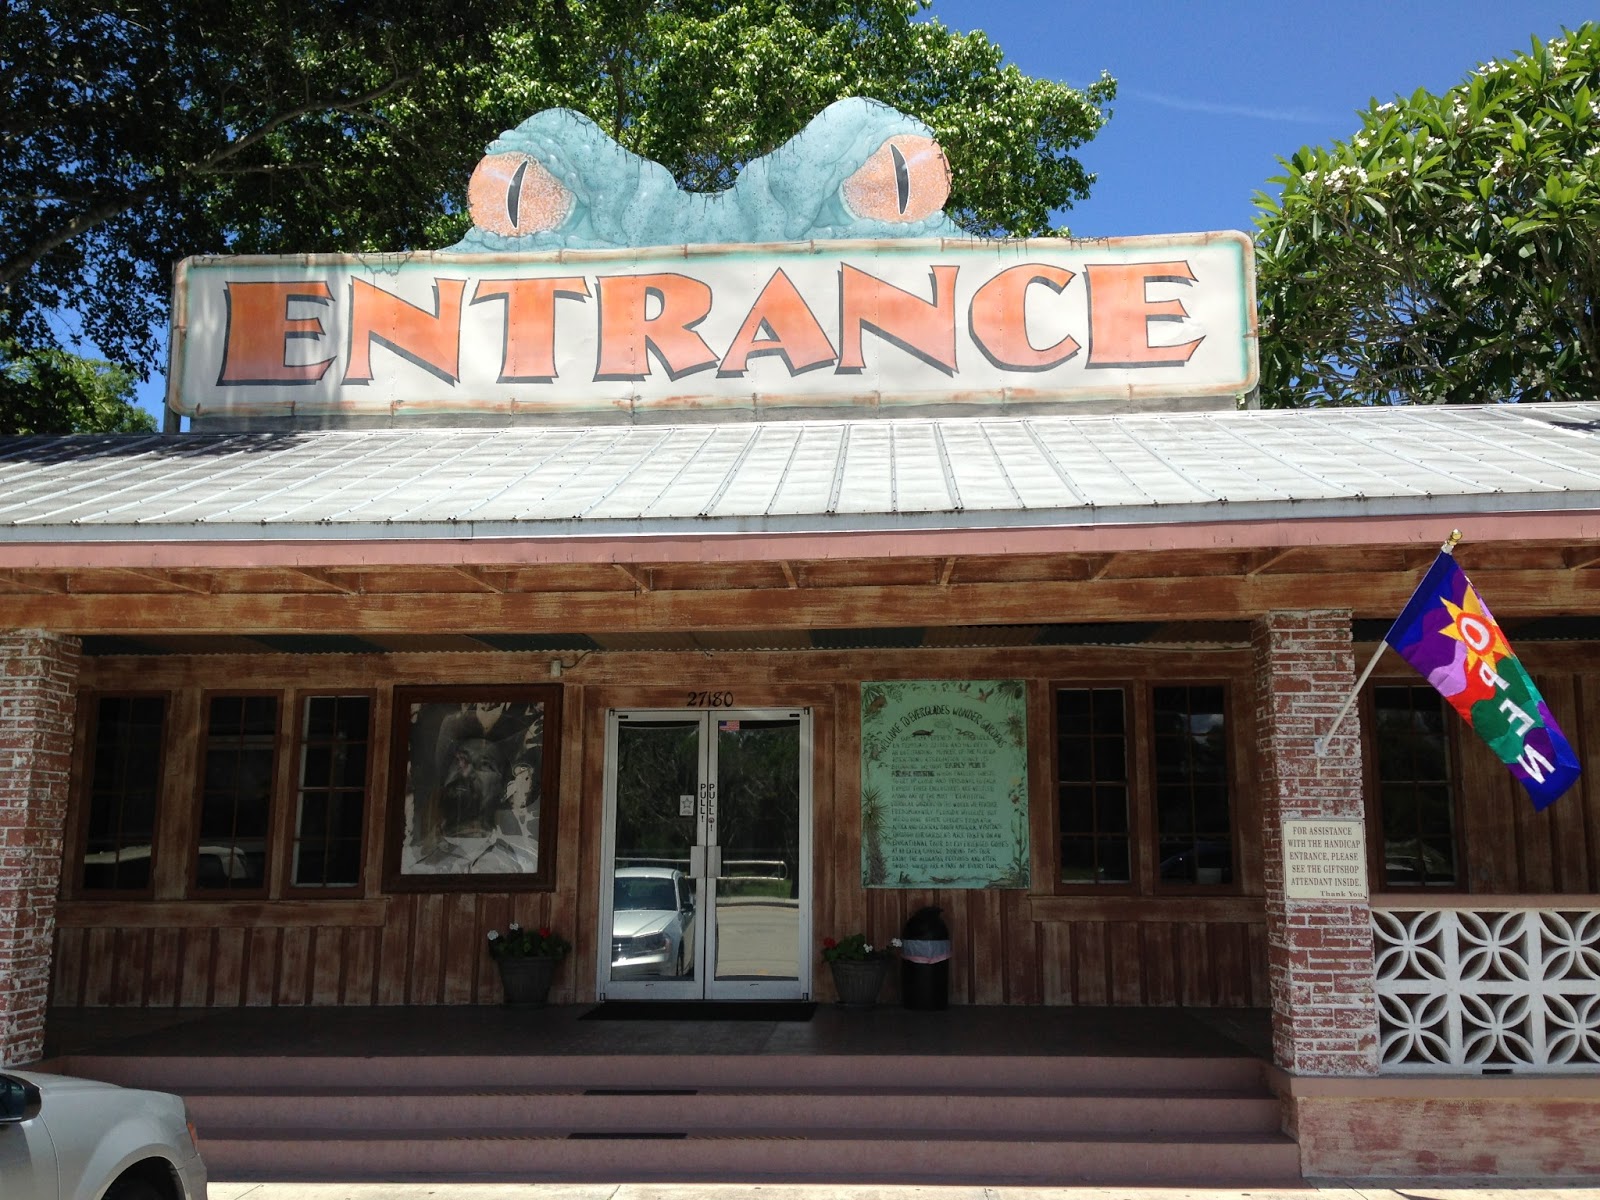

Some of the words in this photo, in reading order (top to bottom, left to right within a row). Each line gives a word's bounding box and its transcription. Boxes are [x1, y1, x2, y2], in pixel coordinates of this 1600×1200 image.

[217, 260, 1206, 388] ENTRANCE
[687, 691, 733, 707] 27180
[881, 722, 902, 752] WELCOME
[900, 716, 911, 728] TO
[908, 704, 950, 723] EVERGLADES
[952, 707, 983, 725] WONDER
[979, 720, 1008, 749] GARDENS
[1293, 827, 1307, 835] FOR
[1309, 827, 1352, 836] ASSISTANCE
[1288, 839, 1306, 848] WITH
[1308, 839, 1322, 848] THE
[1324, 840, 1361, 849] HANDICAP
[1289, 852, 1330, 861] ENTRANCE,
[1331, 852, 1358, 861] PLEASE
[1292, 865, 1306, 873] SEE
[1307, 865, 1322, 873] THE
[1323, 865, 1359, 874] GIFTSHOP
[1291, 877, 1332, 886] ATTENDANT
[1334, 878, 1361, 887] INSIDE.
